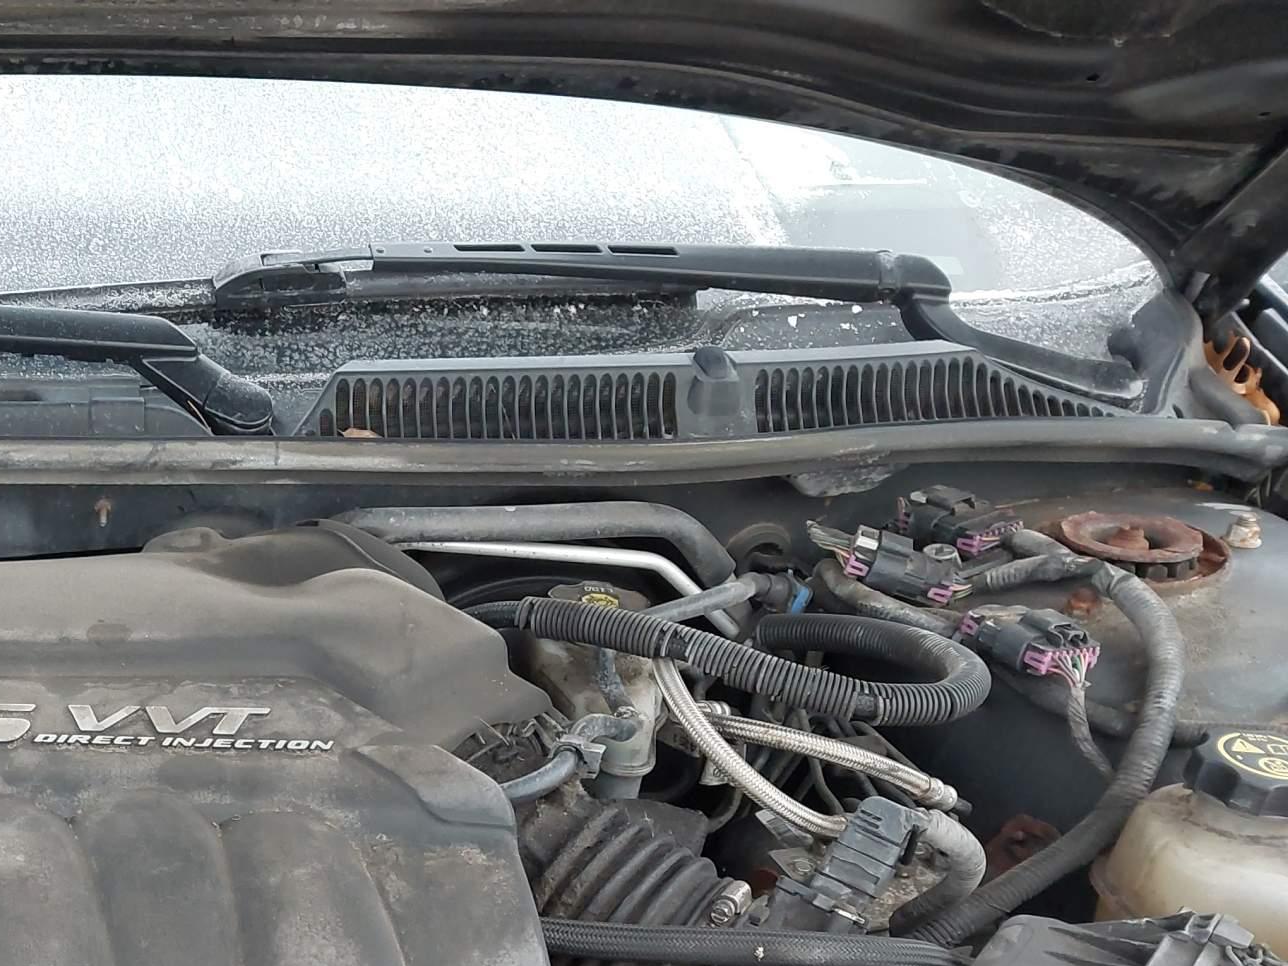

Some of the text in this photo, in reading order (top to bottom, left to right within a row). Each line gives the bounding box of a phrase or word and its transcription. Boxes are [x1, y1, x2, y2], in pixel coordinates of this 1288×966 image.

[68, 704, 271, 734] VVT
[33, 733, 334, 750] DIRECT INJECTION
